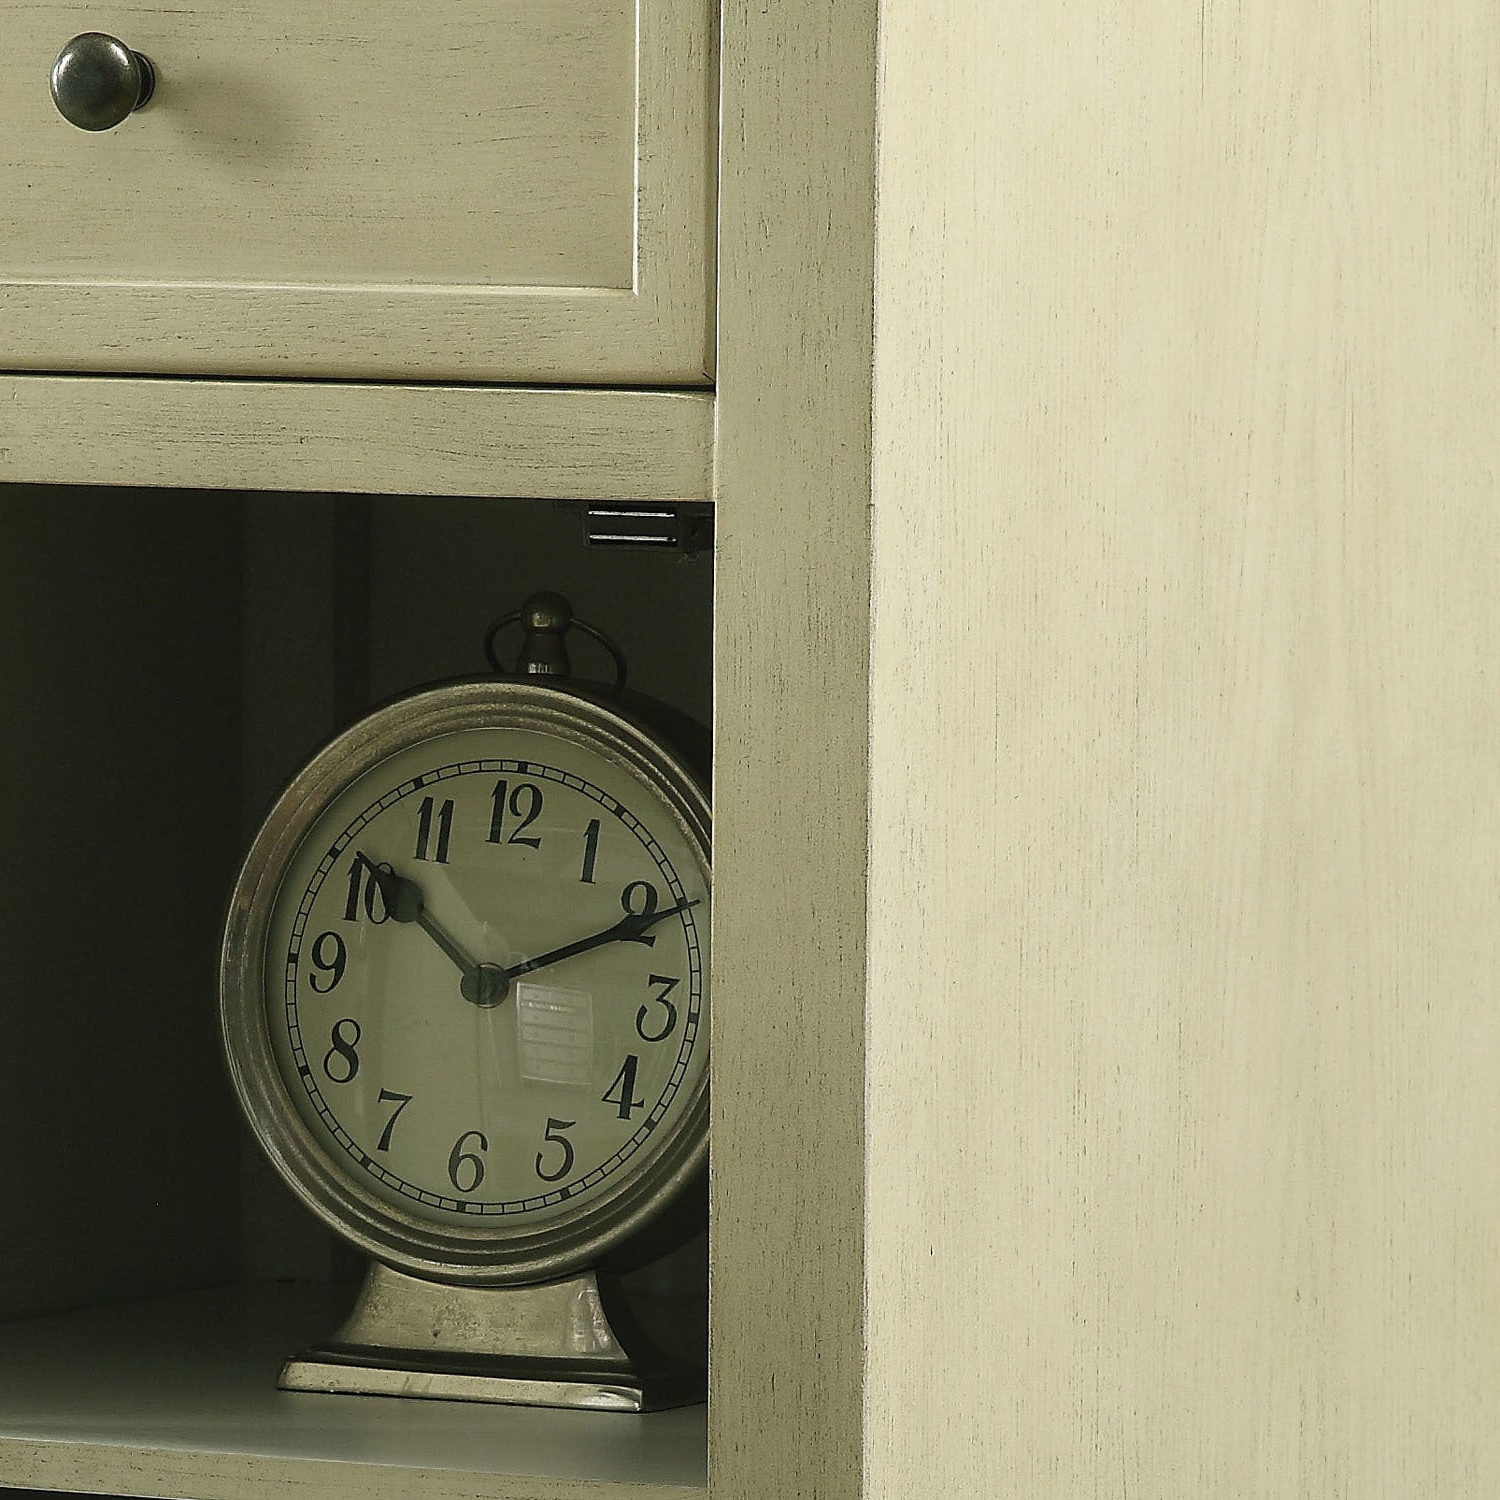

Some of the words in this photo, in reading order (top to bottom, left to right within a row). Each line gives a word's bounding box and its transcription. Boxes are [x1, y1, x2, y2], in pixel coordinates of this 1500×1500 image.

[412, 796, 454, 865] 11
[485, 779, 544, 849] 12
[579, 818, 601, 884] 1
[343, 856, 396, 925] 10
[620, 880, 659, 948] 2
[308, 931, 347, 994] 9
[635, 973, 681, 1043] 3
[322, 1018, 362, 1083] 8
[377, 1087, 413, 1152] 7
[601, 1054, 645, 1120] 4
[447, 1130, 489, 1193] 6
[535, 1117, 577, 1182] 5
